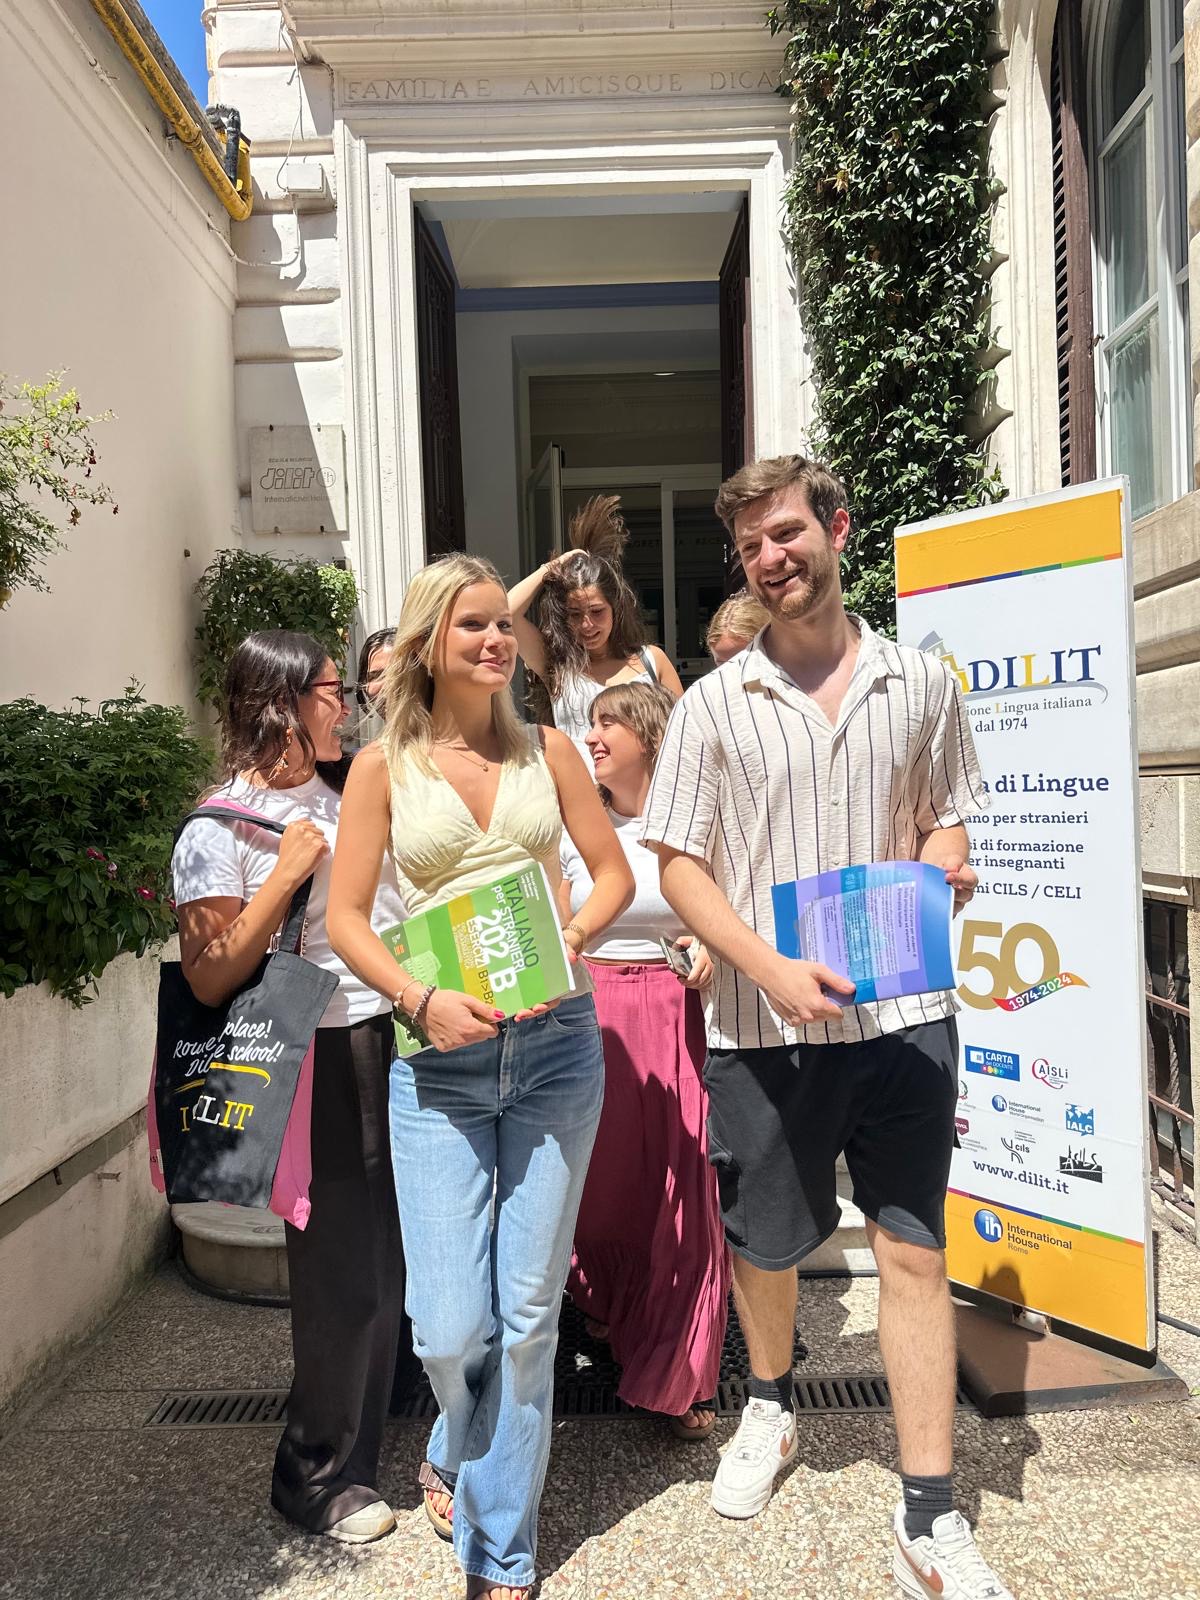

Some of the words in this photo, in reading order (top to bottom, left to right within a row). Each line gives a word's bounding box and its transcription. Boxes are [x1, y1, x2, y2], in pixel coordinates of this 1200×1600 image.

[348, 79, 491, 100] FAMILIAE
[524, 73, 682, 95] AMICISQUE
[260, 467, 315, 489] dilit
[967, 645, 1101, 692] DILIT
[966, 704, 991, 716] ione
[994, 702, 1039, 715] Lingua
[1043, 697, 1092, 710] italiana
[975, 720, 995, 732] dal
[999, 717, 1028, 731] 1974
[995, 774, 1017, 793] di
[1022, 773, 1109, 797] Lingue
[965, 815, 990, 824] ano
[993, 815, 1017, 826] per
[1020, 811, 1088, 824] stranieri
[980, 839, 994, 851] di
[996, 839, 1084, 853] formazione
[968, 857, 982, 867] er
[984, 855, 1065, 871] insegnanti
[993, 882, 1028, 896] CILS
[1043, 885, 1081, 899] CELI
[491, 885, 507, 905] per
[501, 906, 526, 972] STRANIERI
[503, 878, 539, 968] ITALIANO
[466, 919, 485, 969] ESERCIZI
[475, 909, 511, 965] 202
[956, 919, 1060, 1010] 50
[489, 967, 517, 993] B
[1008, 975, 1072, 1010] 1974-2024
[218, 1016, 273, 1042] place!
[227, 1038, 285, 1062] school!
[985, 1051, 1014, 1065] CARTA
[1008, 1101, 1041, 1112] International
[1008, 1106, 1026, 1114] House
[1067, 1121, 1093, 1134] IALC
[1015, 1144, 1030, 1154] cils
[973, 1160, 1069, 1194] www.dilit.it
[1007, 1222, 1072, 1250] International
[1007, 1232, 1040, 1250] House
[1008, 1242, 1029, 1255] Rome
